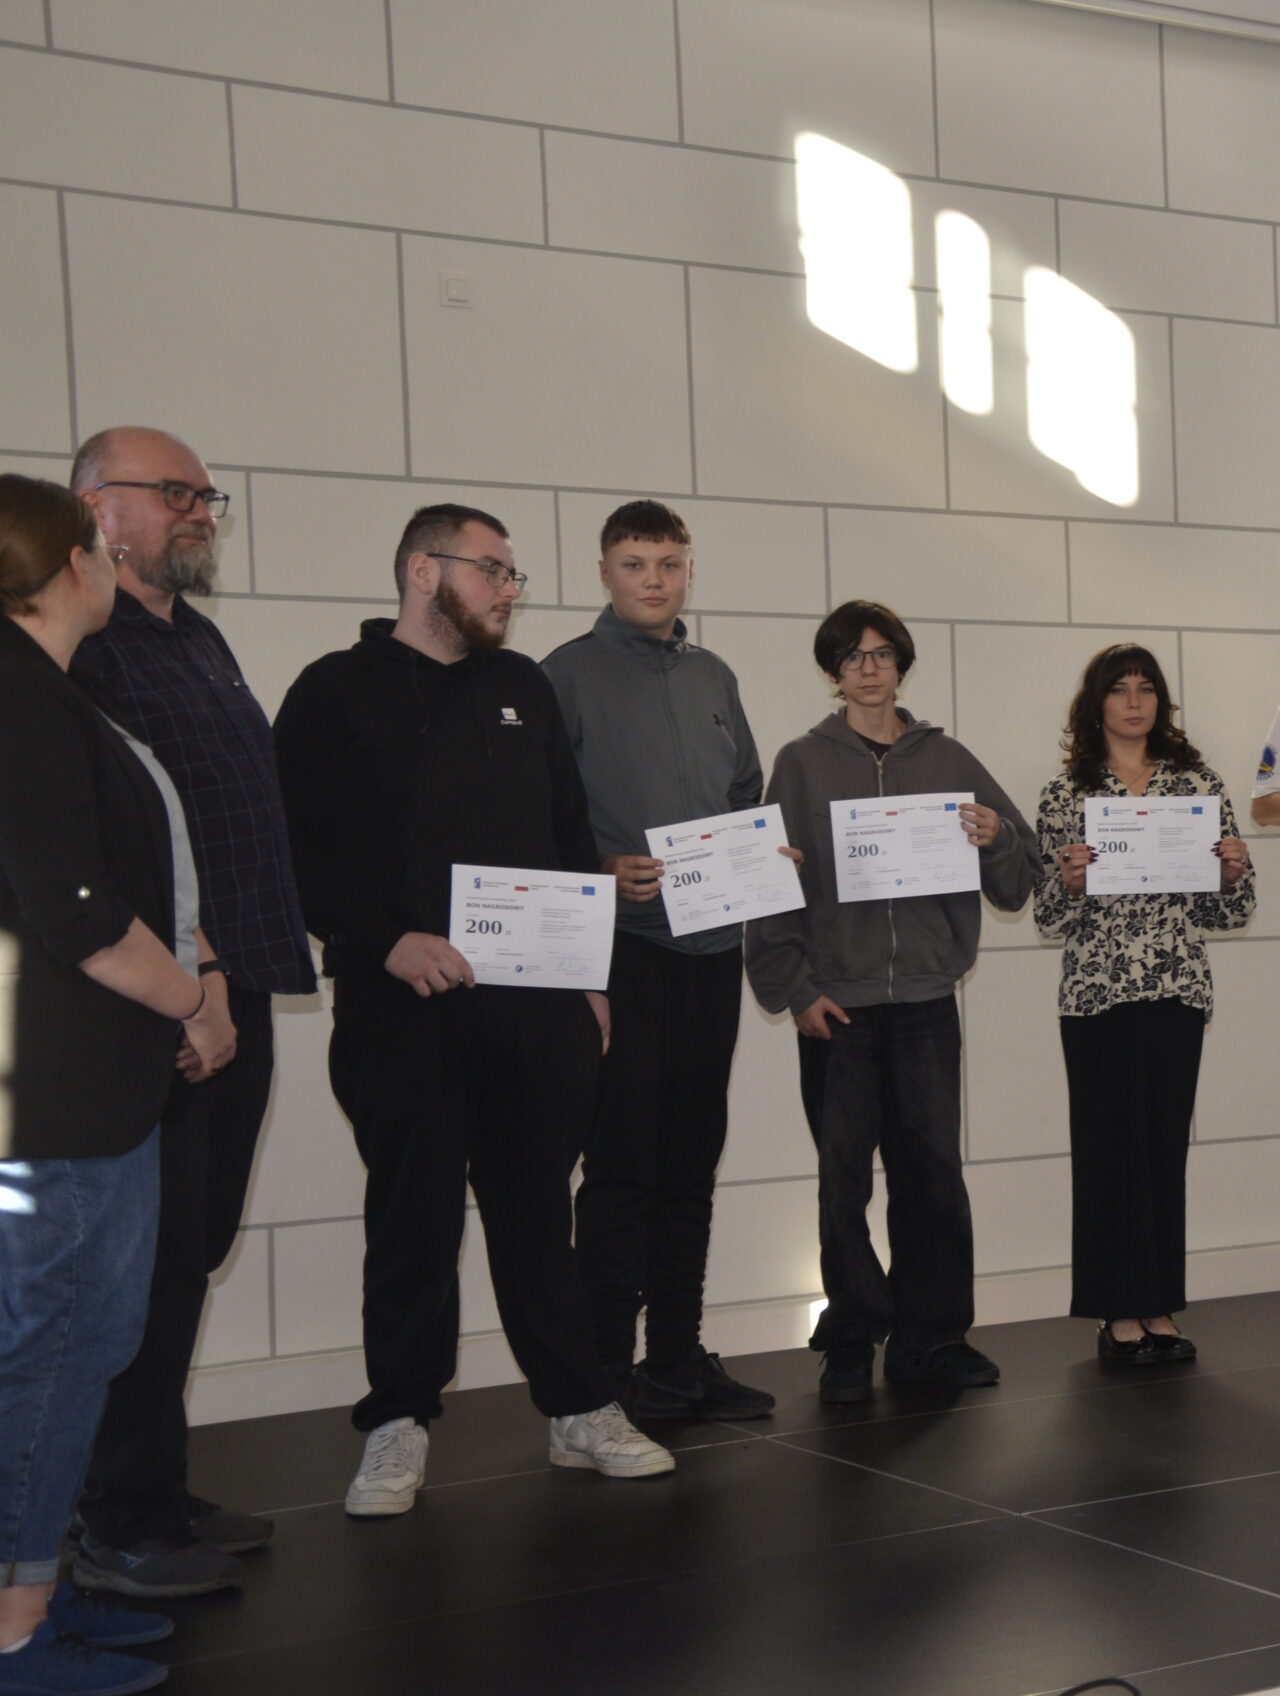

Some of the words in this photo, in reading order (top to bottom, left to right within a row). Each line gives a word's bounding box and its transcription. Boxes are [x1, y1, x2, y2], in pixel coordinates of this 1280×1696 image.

[847, 843, 879, 859] 200
[1098, 841, 1128, 853] 200
[670, 870, 702, 889] 200
[481, 903, 524, 911] NAGRODOWY
[465, 919, 503, 935] 200
